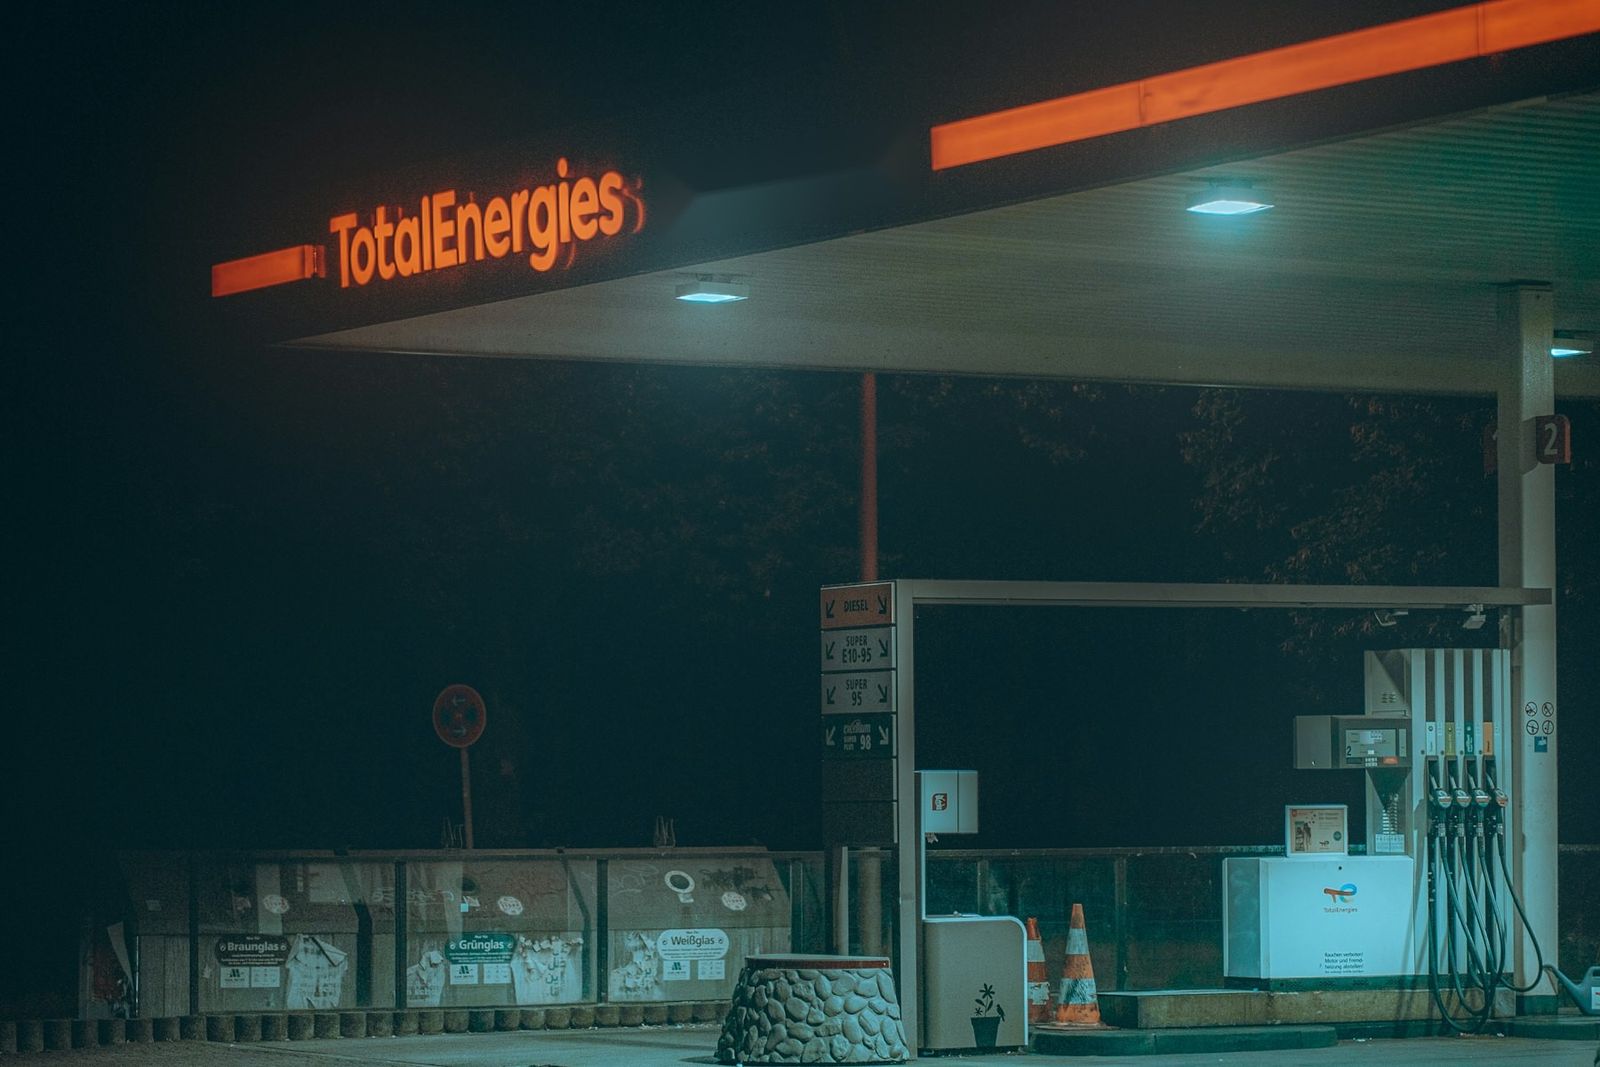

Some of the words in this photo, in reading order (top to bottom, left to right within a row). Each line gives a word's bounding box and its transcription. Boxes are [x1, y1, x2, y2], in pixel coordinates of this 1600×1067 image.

[330, 157, 625, 288] TotalEnergies
[1544, 422, 1558, 456] 2
[843, 600, 869, 613] DIESEL
[846, 635, 868, 647] SUPER
[842, 648, 872, 664] E10-95
[846, 679, 868, 690] SUPER
[851, 692, 863, 706] 95
[860, 734, 872, 750] 98
[1346, 745, 1352, 756] 2
[227, 941, 279, 953] Braunglas
[459, 939, 504, 952] Grünglas
[671, 935, 715, 948] Weißglas
